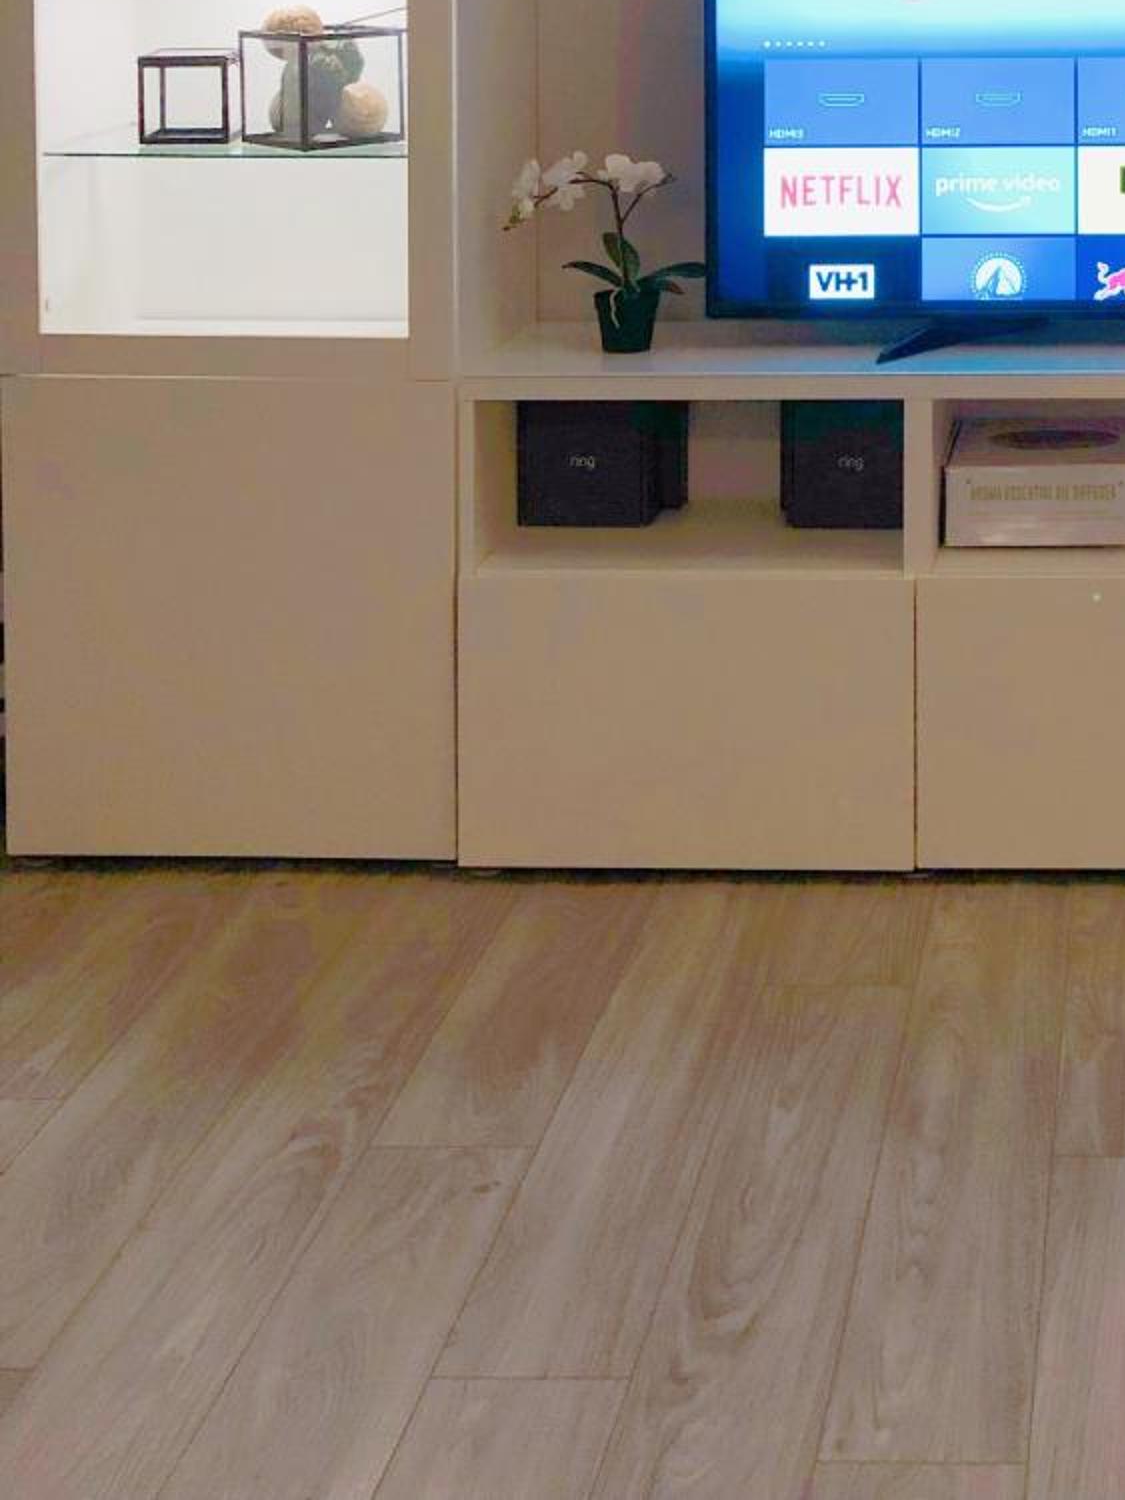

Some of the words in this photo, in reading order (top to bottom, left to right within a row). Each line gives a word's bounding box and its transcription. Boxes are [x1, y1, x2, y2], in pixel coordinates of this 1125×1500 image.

[780, 175, 903, 208] NETFLIX
[935, 174, 997, 195] prime
[1004, 171, 1060, 193] video
[570, 454, 595, 471] ring
[838, 454, 864, 471] ring
